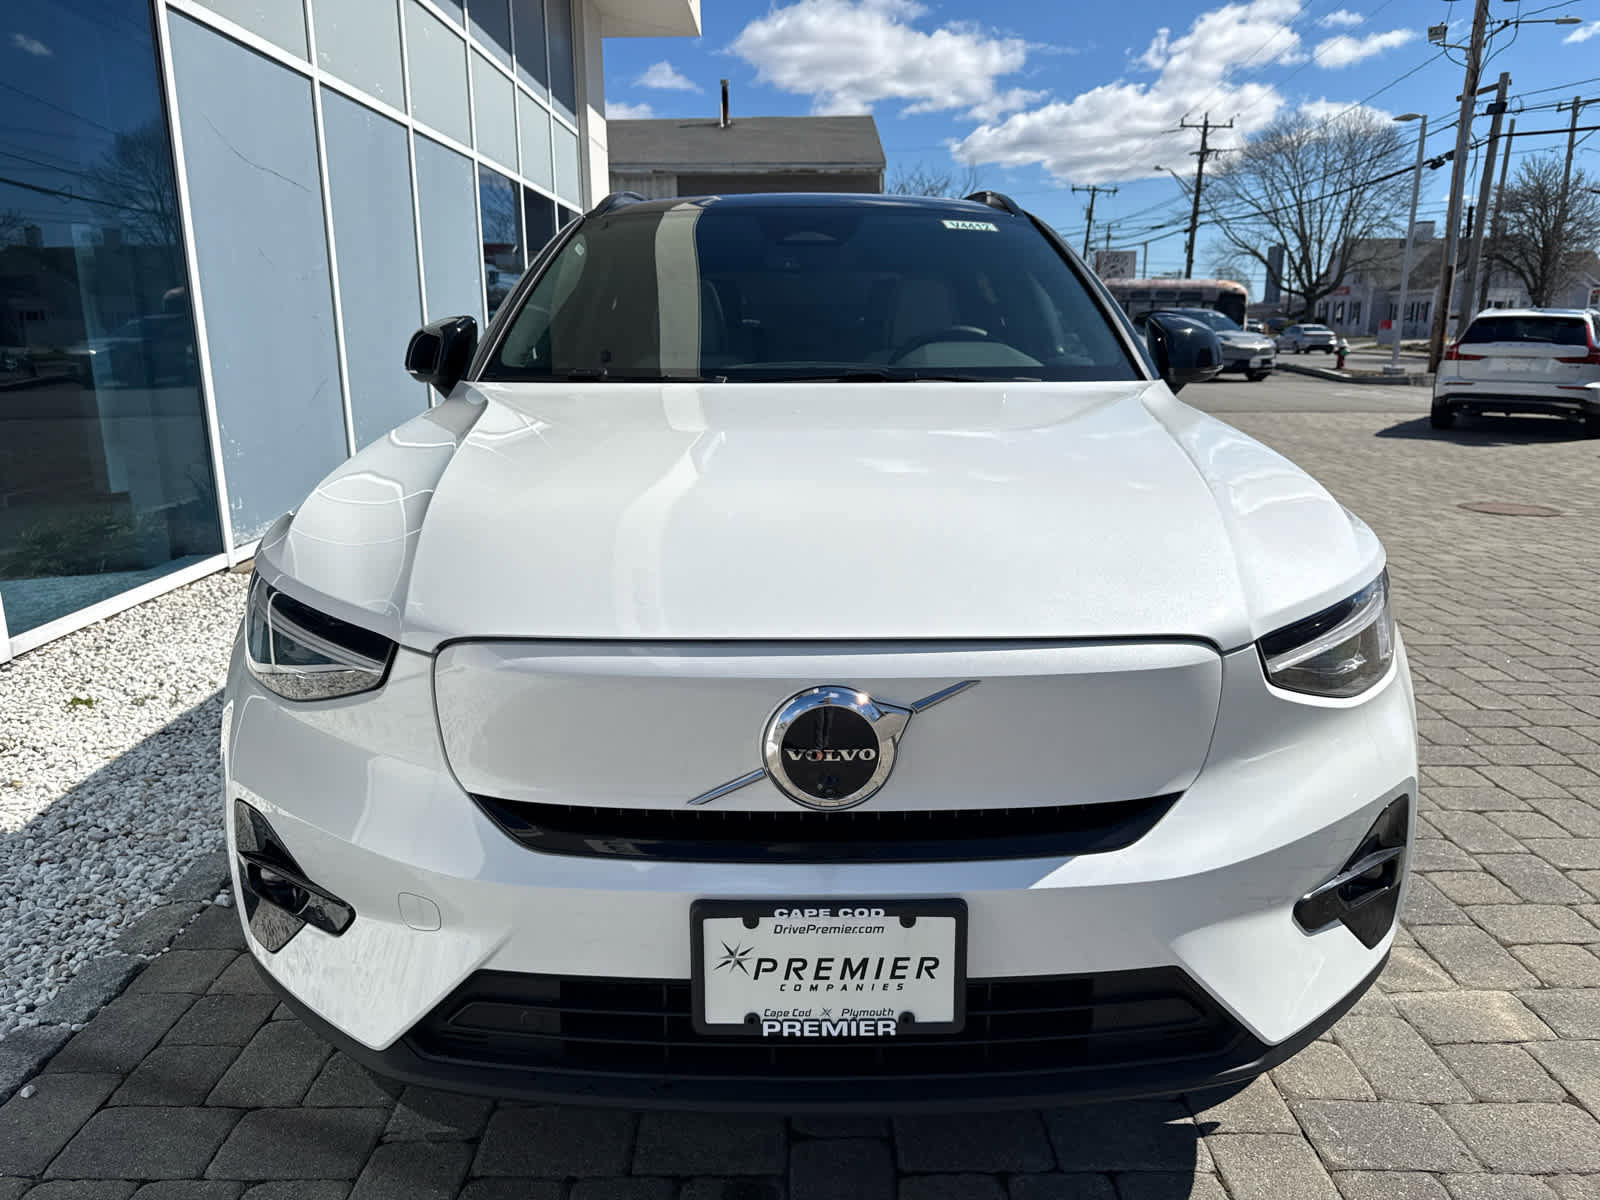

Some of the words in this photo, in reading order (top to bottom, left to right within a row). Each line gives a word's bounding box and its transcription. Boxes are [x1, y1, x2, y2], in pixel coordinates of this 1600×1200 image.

[784, 748, 876, 762] VOLVO
[774, 908, 831, 919] CAPE
[838, 908, 886, 919] COD
[773, 924, 885, 934] DrivePremier.com
[753, 957, 940, 980] PREMIER
[779, 983, 904, 992] COMPANIES
[763, 1008, 790, 1019] Cape
[792, 1008, 812, 1017] Cod
[841, 1007, 894, 1018] Plymouth
[762, 1020, 897, 1037] PREMIER
